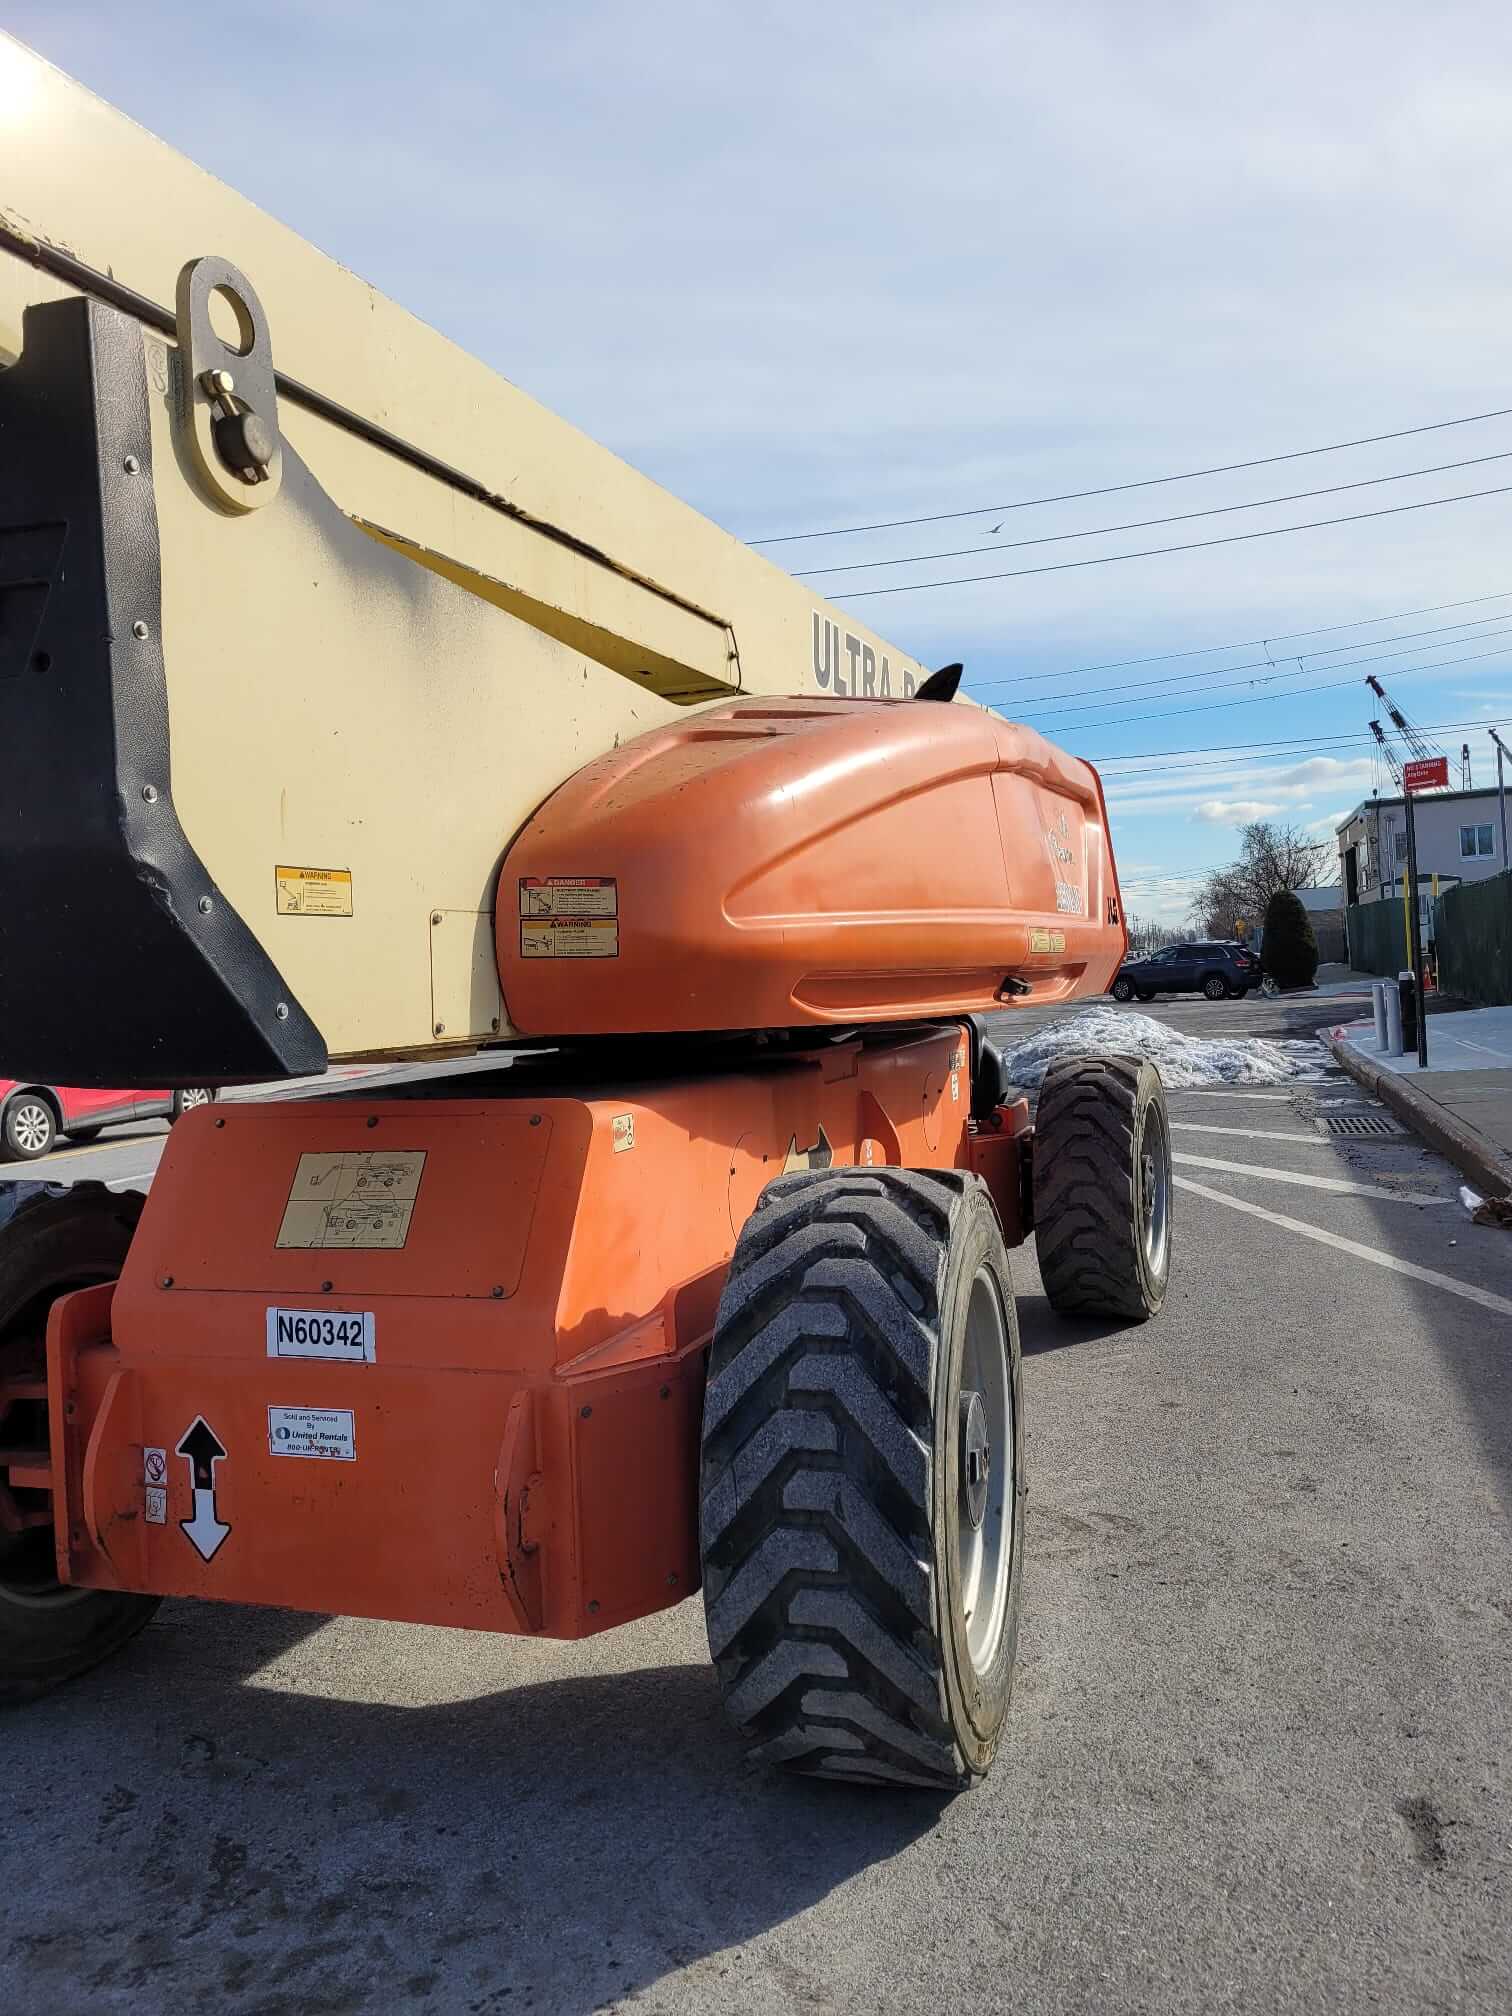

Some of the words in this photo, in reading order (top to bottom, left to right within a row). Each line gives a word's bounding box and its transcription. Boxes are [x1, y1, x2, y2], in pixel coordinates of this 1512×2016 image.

[813, 611, 891, 699] ULTRA
[304, 871, 332, 880] WARNING
[279, 1315, 362, 1347] N60342
[306, 1422, 315, 1430] By
[292, 1431, 318, 1440] United
[319, 1432, 348, 1442] Rentals
